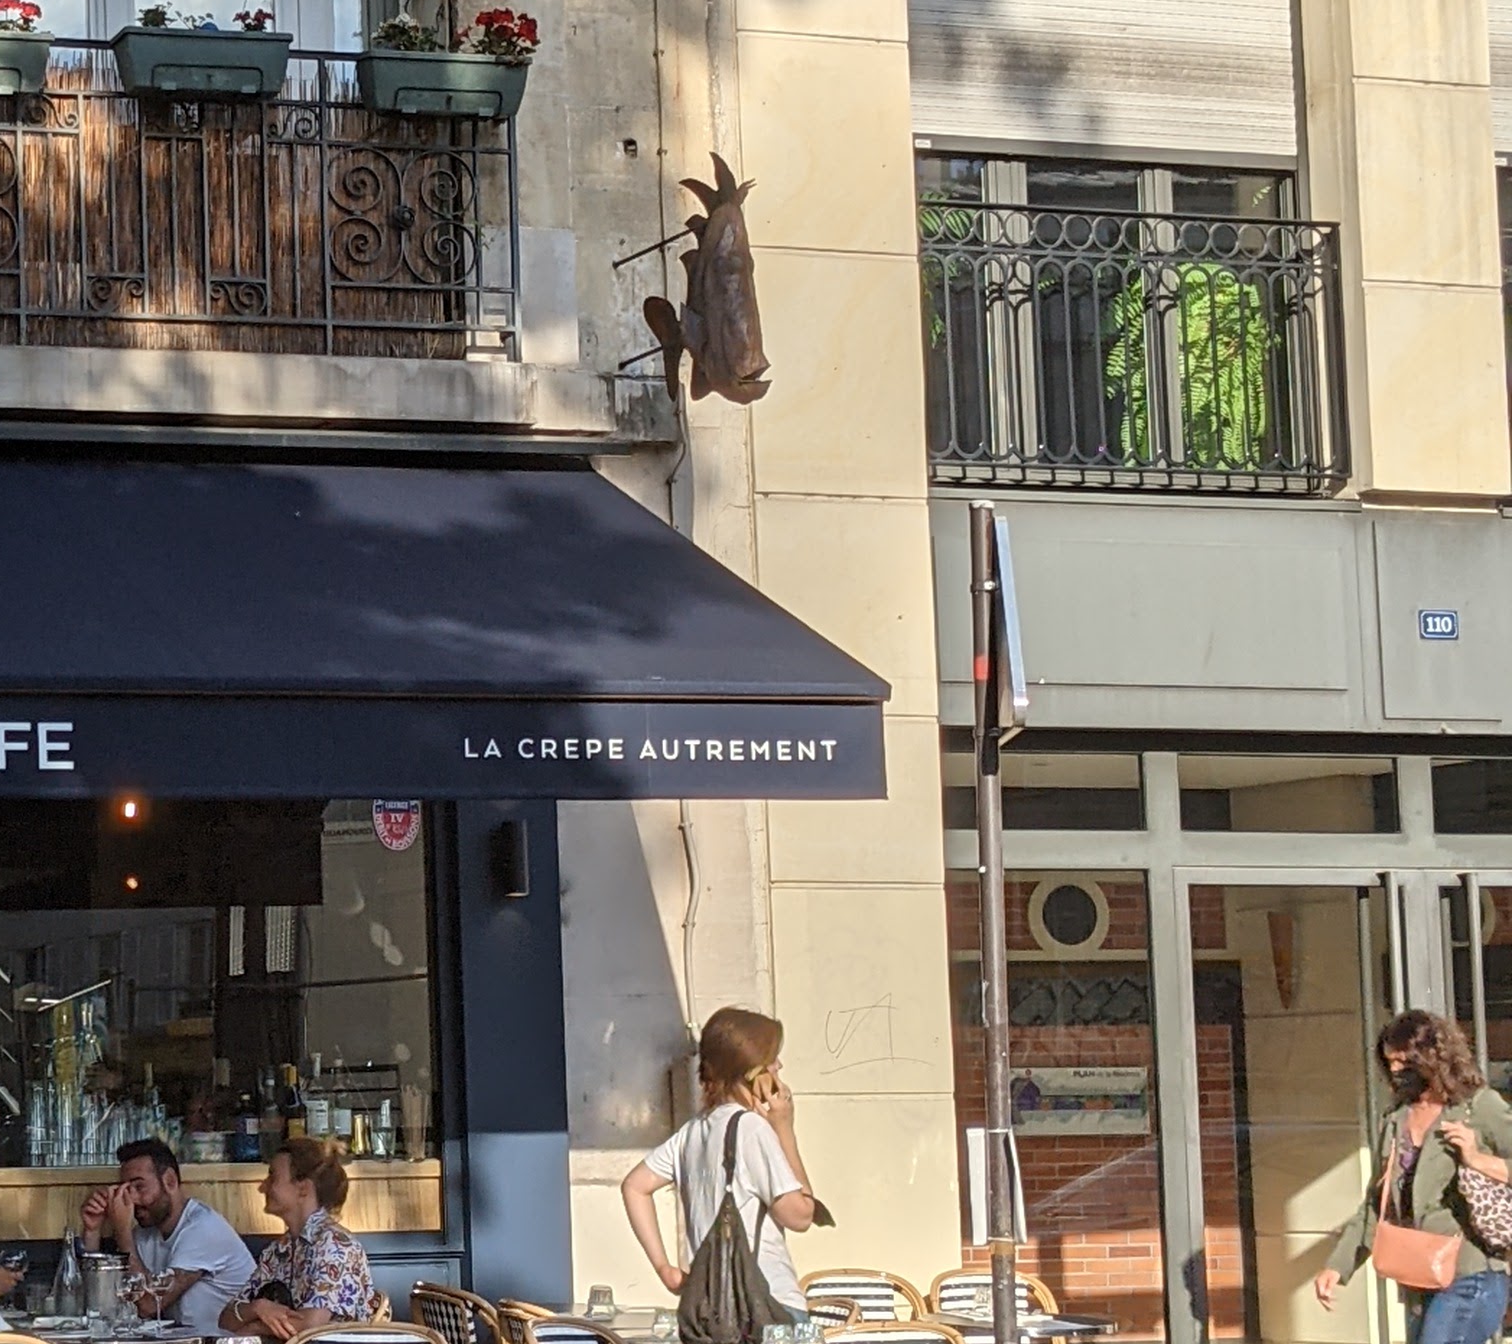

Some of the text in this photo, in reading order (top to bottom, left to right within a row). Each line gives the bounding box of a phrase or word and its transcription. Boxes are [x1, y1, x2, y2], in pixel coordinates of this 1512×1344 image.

[1426, 616, 1453, 633] 110
[464, 738, 838, 761] LA CREPE AUTREMENT
[391, 813, 404, 823] IV
